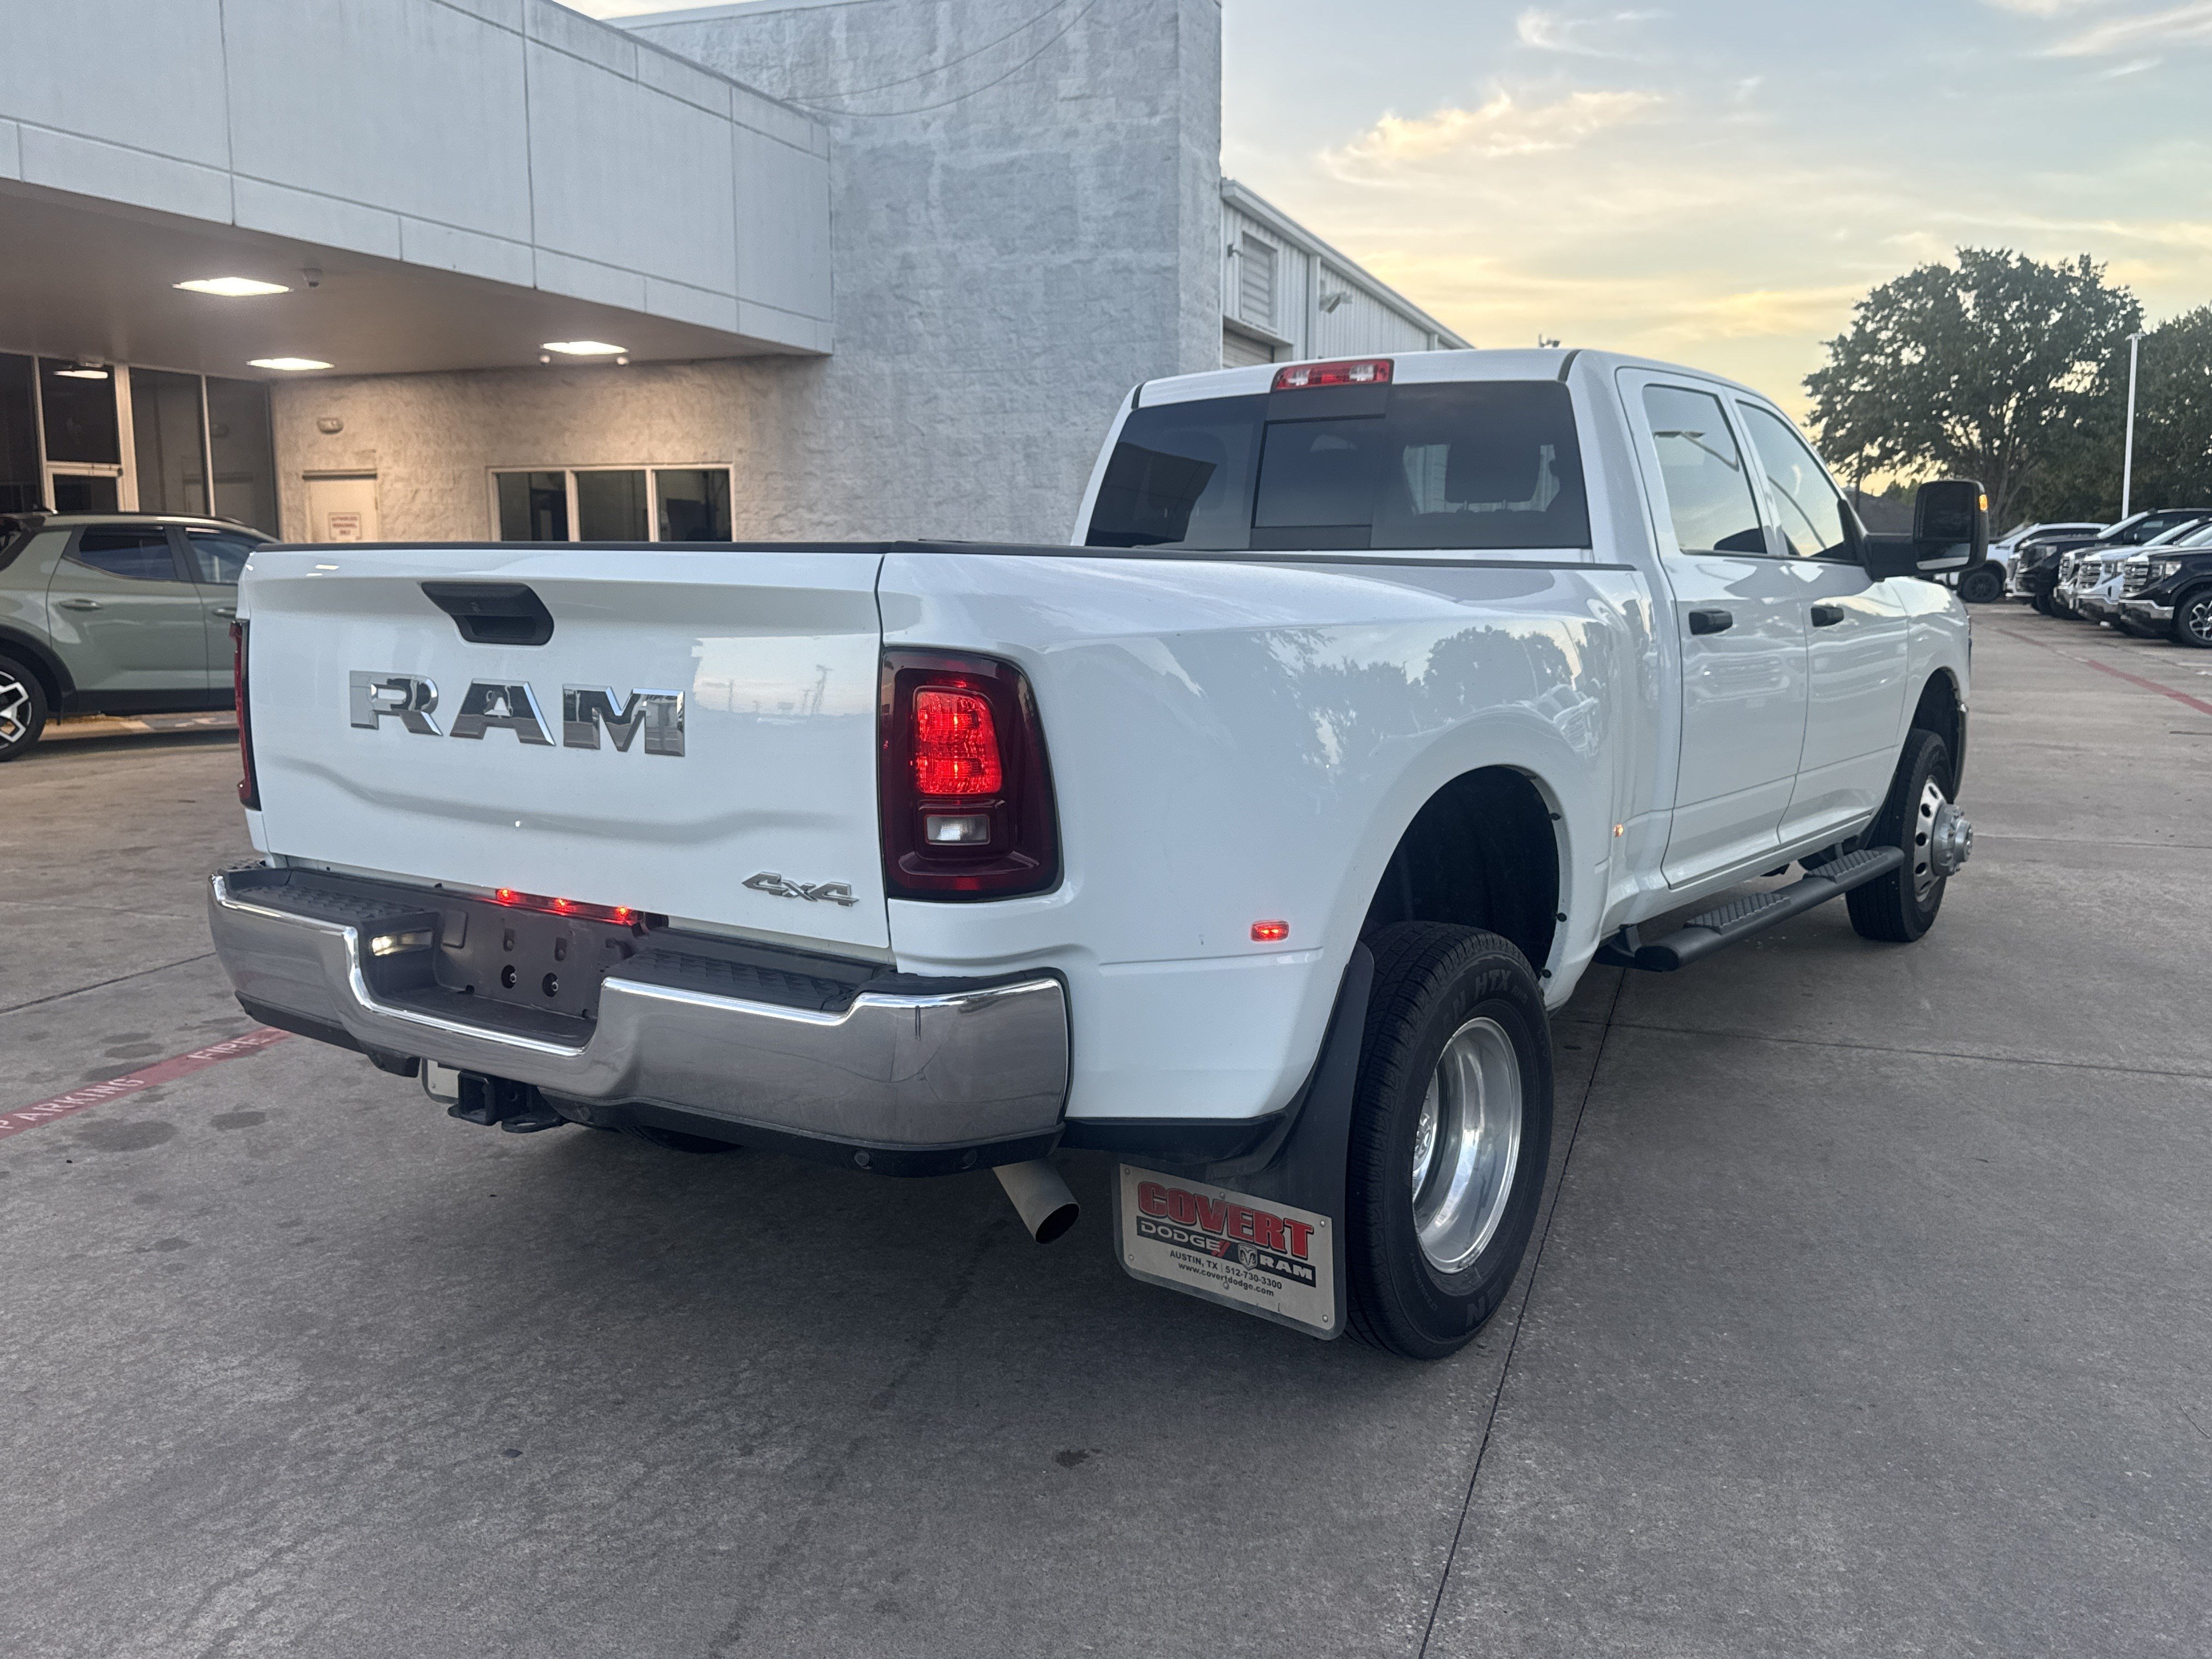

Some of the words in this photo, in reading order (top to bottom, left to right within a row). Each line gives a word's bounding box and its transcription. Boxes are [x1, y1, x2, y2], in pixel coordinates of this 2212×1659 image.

[349, 670, 685, 757] RAM
[1474, 969, 1512, 1001] HTX
[1137, 1181, 1314, 1261] COVERT
[1141, 1220, 1221, 1252] DODGE
[1259, 1253, 1313, 1281] RAM
[1170, 1249, 1205, 1268] AUSTIN,
[1206, 1260, 1218, 1270] TX
[1225, 1265, 1283, 1290] 512-730-3300
[1178, 1262, 1274, 1297] www.covertdodge.com
